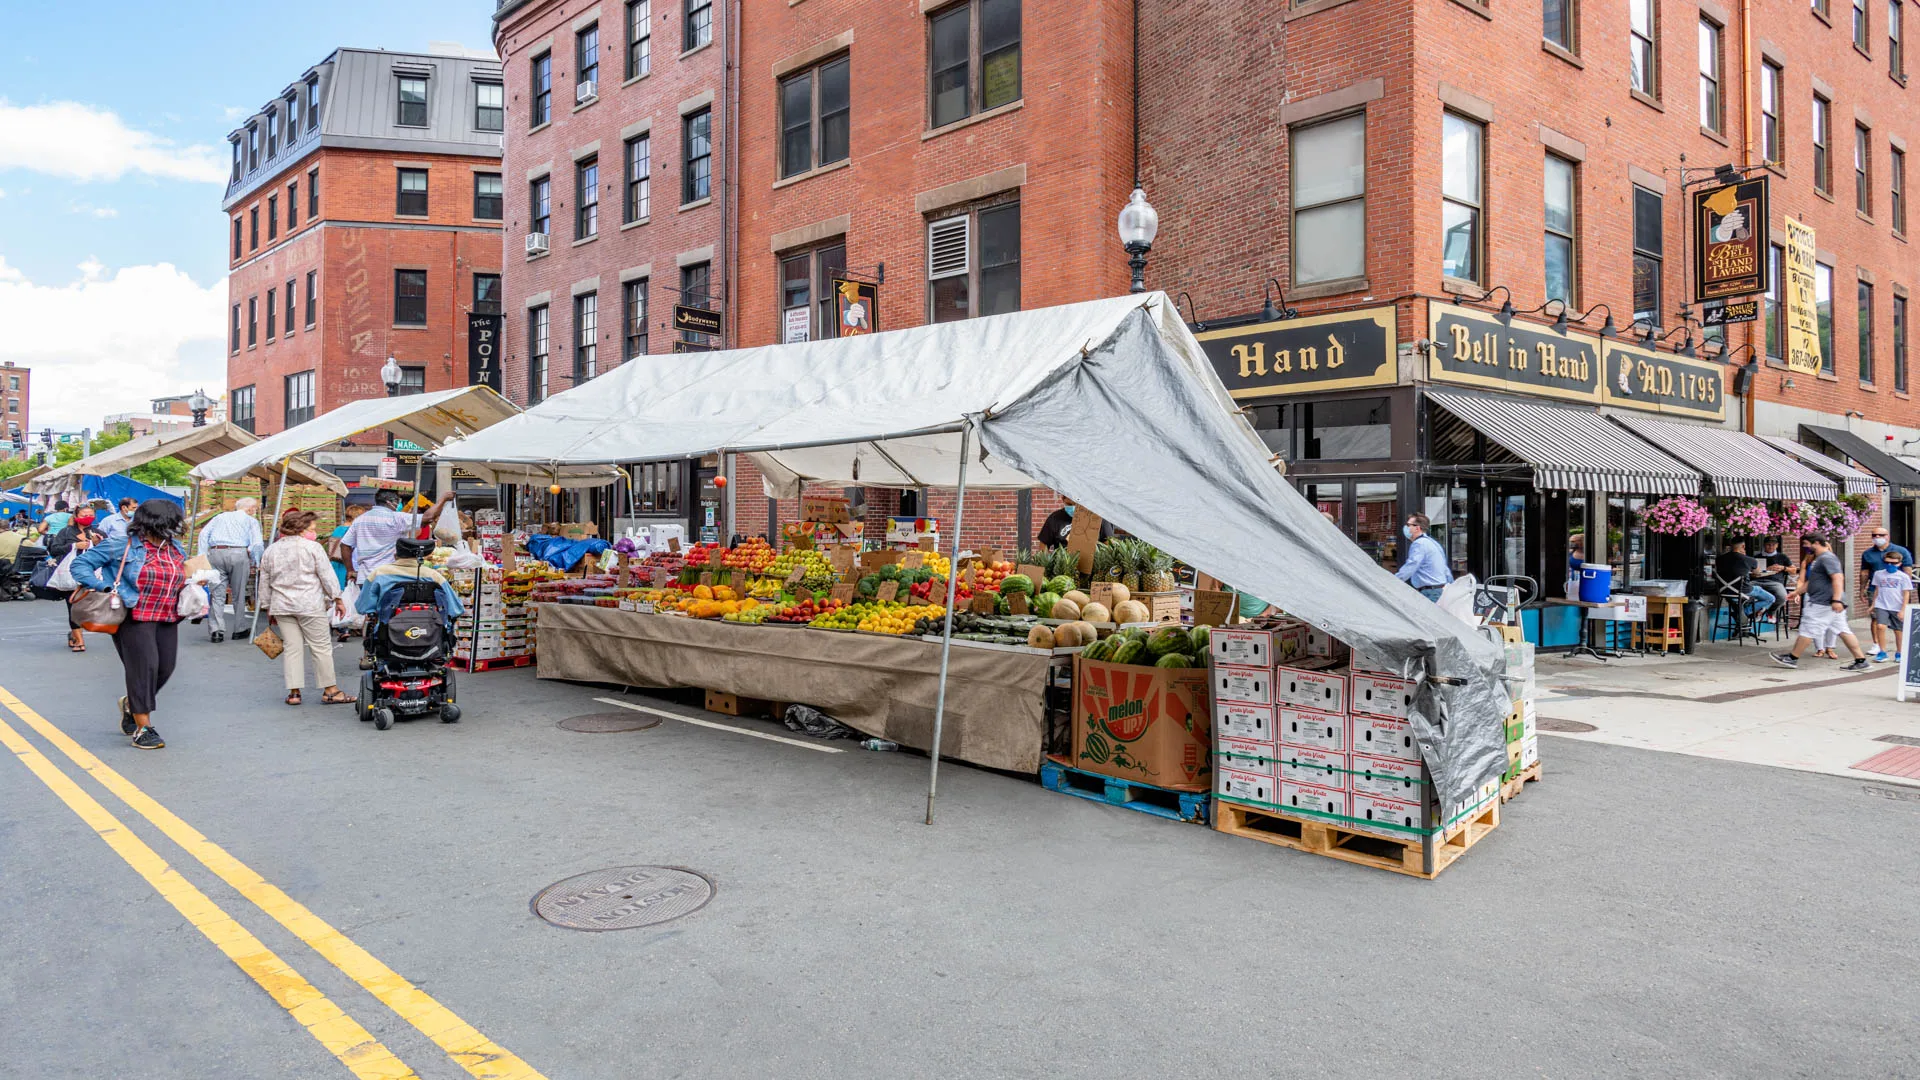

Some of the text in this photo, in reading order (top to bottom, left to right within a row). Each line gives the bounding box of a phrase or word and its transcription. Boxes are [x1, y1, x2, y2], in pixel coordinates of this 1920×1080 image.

[1725, 302, 1756, 313] SAMUEL
[471, 318, 491, 328] The
[476, 329, 492, 383] POIN
[1230, 333, 1345, 378] Hand
[1449, 323, 1589, 382] Bell in Hand
[1679, 372, 1715, 403] 1795
[1108, 698, 1143, 723] melon
[1123, 715, 1143, 735] UP!
